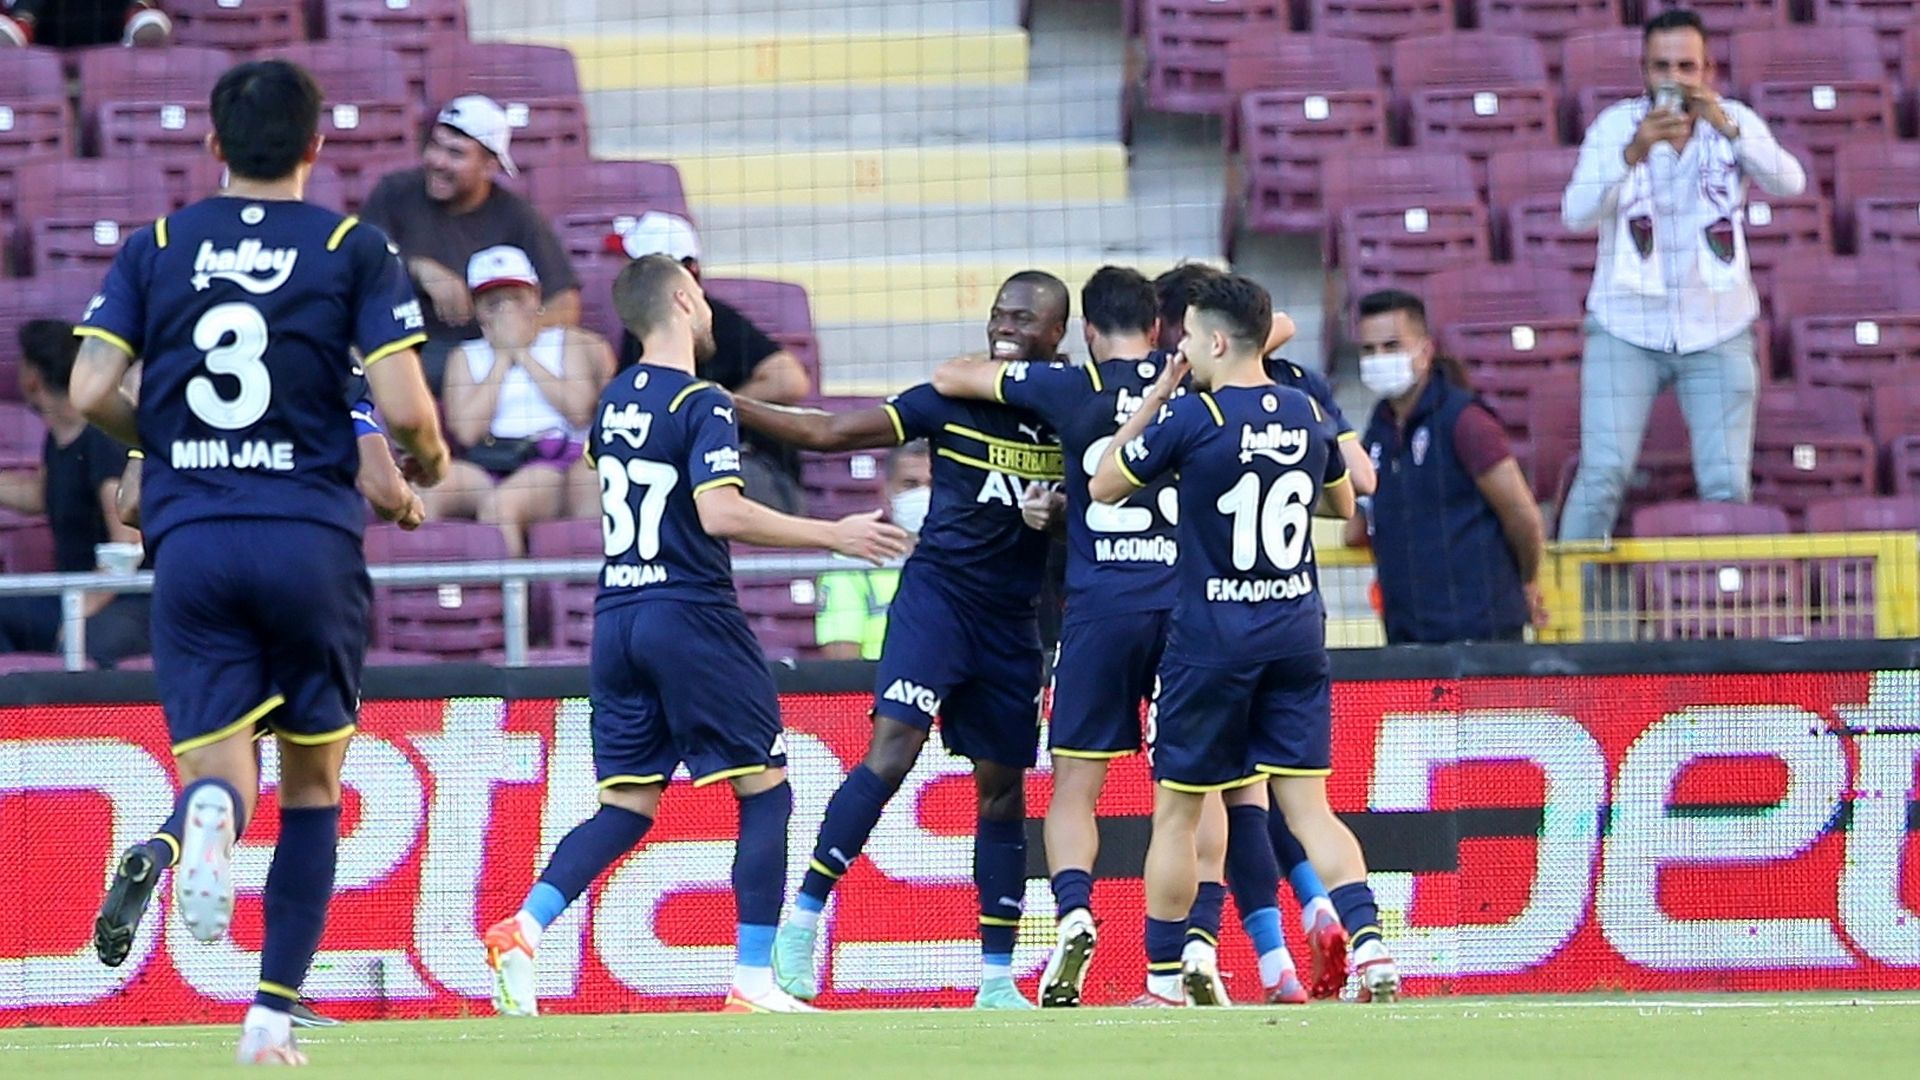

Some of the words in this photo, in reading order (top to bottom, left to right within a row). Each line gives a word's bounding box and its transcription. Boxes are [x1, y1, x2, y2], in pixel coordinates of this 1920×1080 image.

[191, 238, 298, 294] halley
[186, 302, 271, 430] 3
[172, 439, 229, 469] MIN
[232, 440, 295, 470] JAE
[598, 454, 679, 561] 37
[1217, 470, 1314, 571] 16
